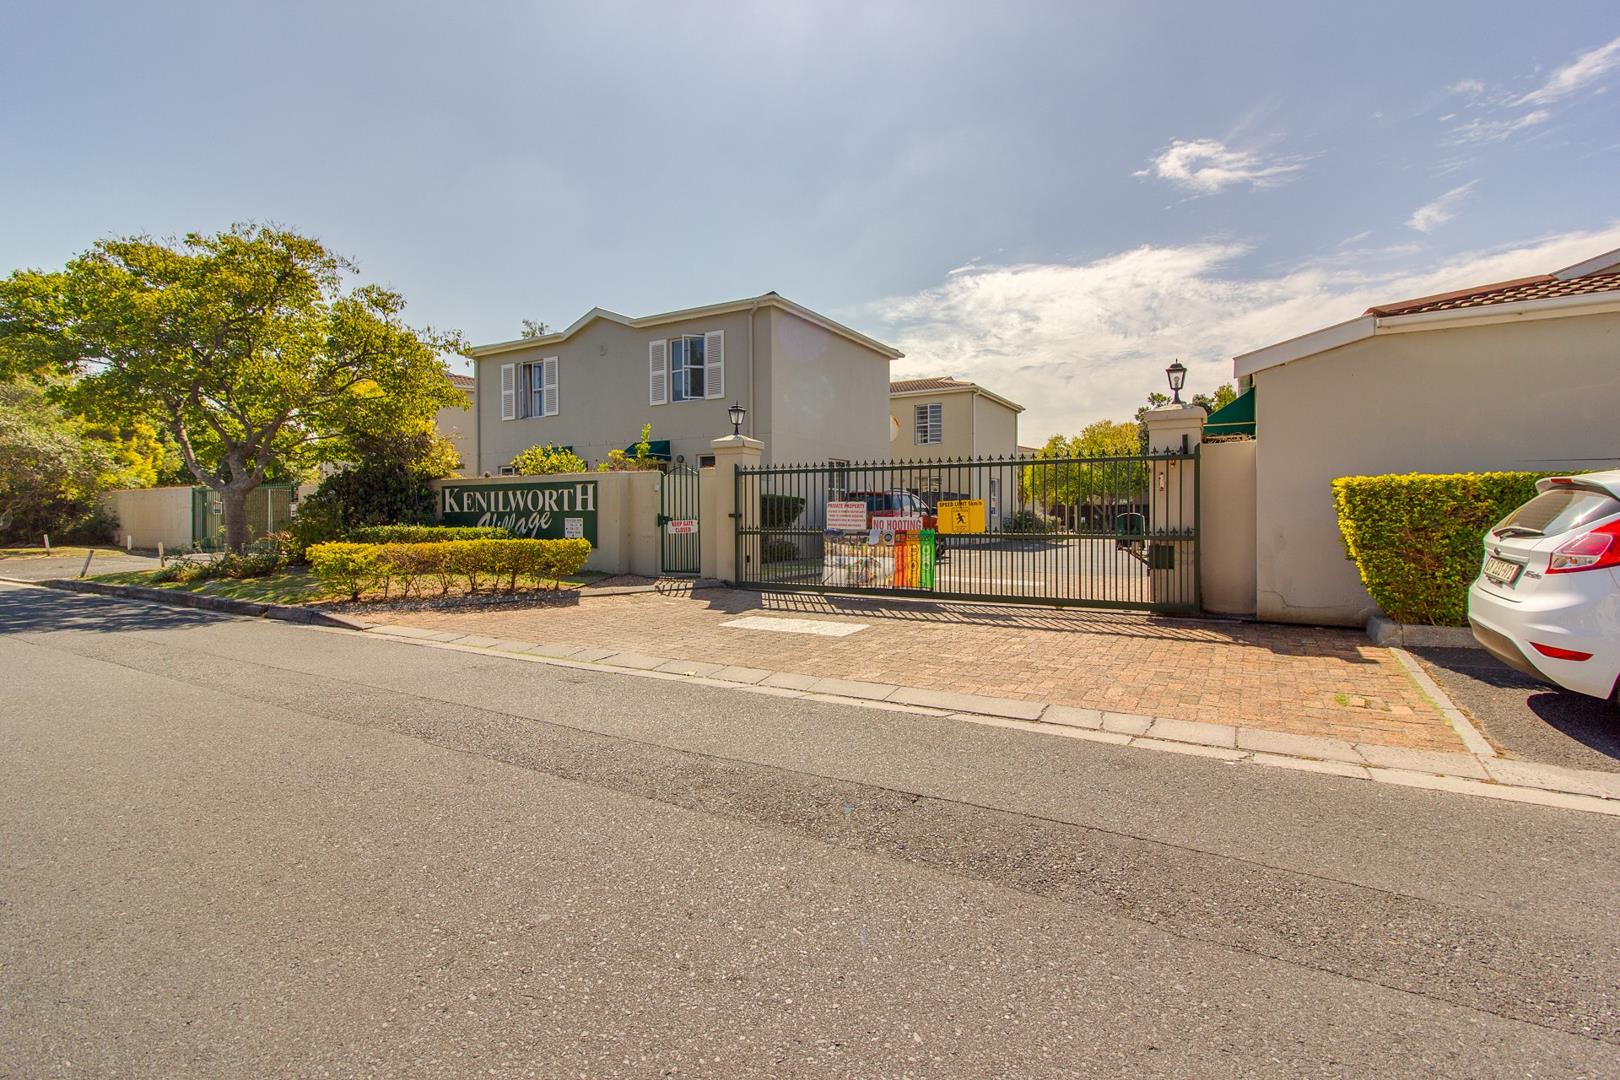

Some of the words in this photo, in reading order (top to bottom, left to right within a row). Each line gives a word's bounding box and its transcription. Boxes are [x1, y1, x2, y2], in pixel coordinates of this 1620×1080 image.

[444, 484, 596, 513] KENILWORTH
[873, 519, 885, 530] NO
[886, 519, 922, 531] HOOTING
